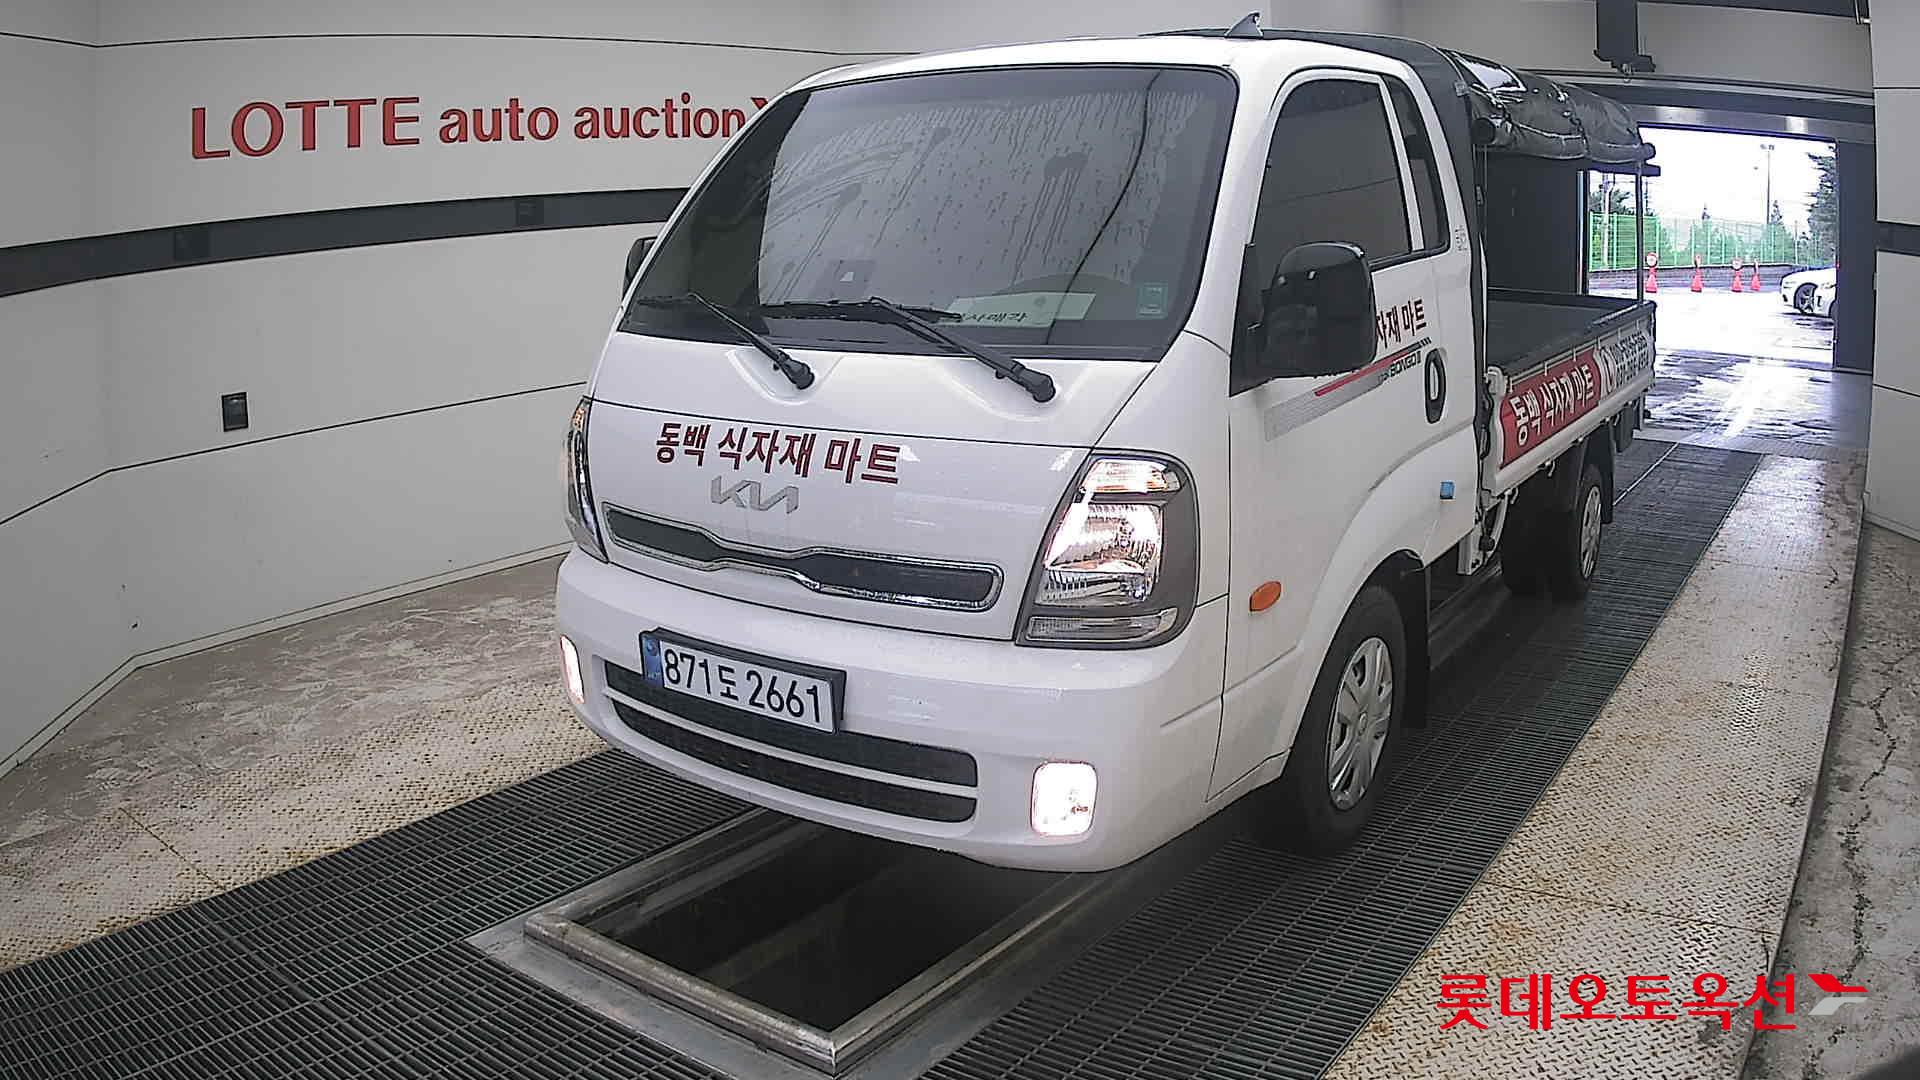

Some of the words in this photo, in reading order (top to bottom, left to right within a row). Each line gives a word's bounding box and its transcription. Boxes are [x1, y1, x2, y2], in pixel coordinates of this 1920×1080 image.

[191, 96, 421, 160] LOTTE
[438, 97, 560, 144] auto
[573, 93, 746, 139] auction
[1401, 299, 1427, 337] 마트
[1509, 389, 1541, 446] 동백
[1539, 376, 1576, 427] 식자재
[1571, 366, 1595, 408] 마트
[655, 422, 711, 466] 동백
[717, 426, 818, 478] 식자재
[823, 438, 901, 484] 마트
[664, 648, 740, 702] 871도
[745, 669, 821, 723] 2661
